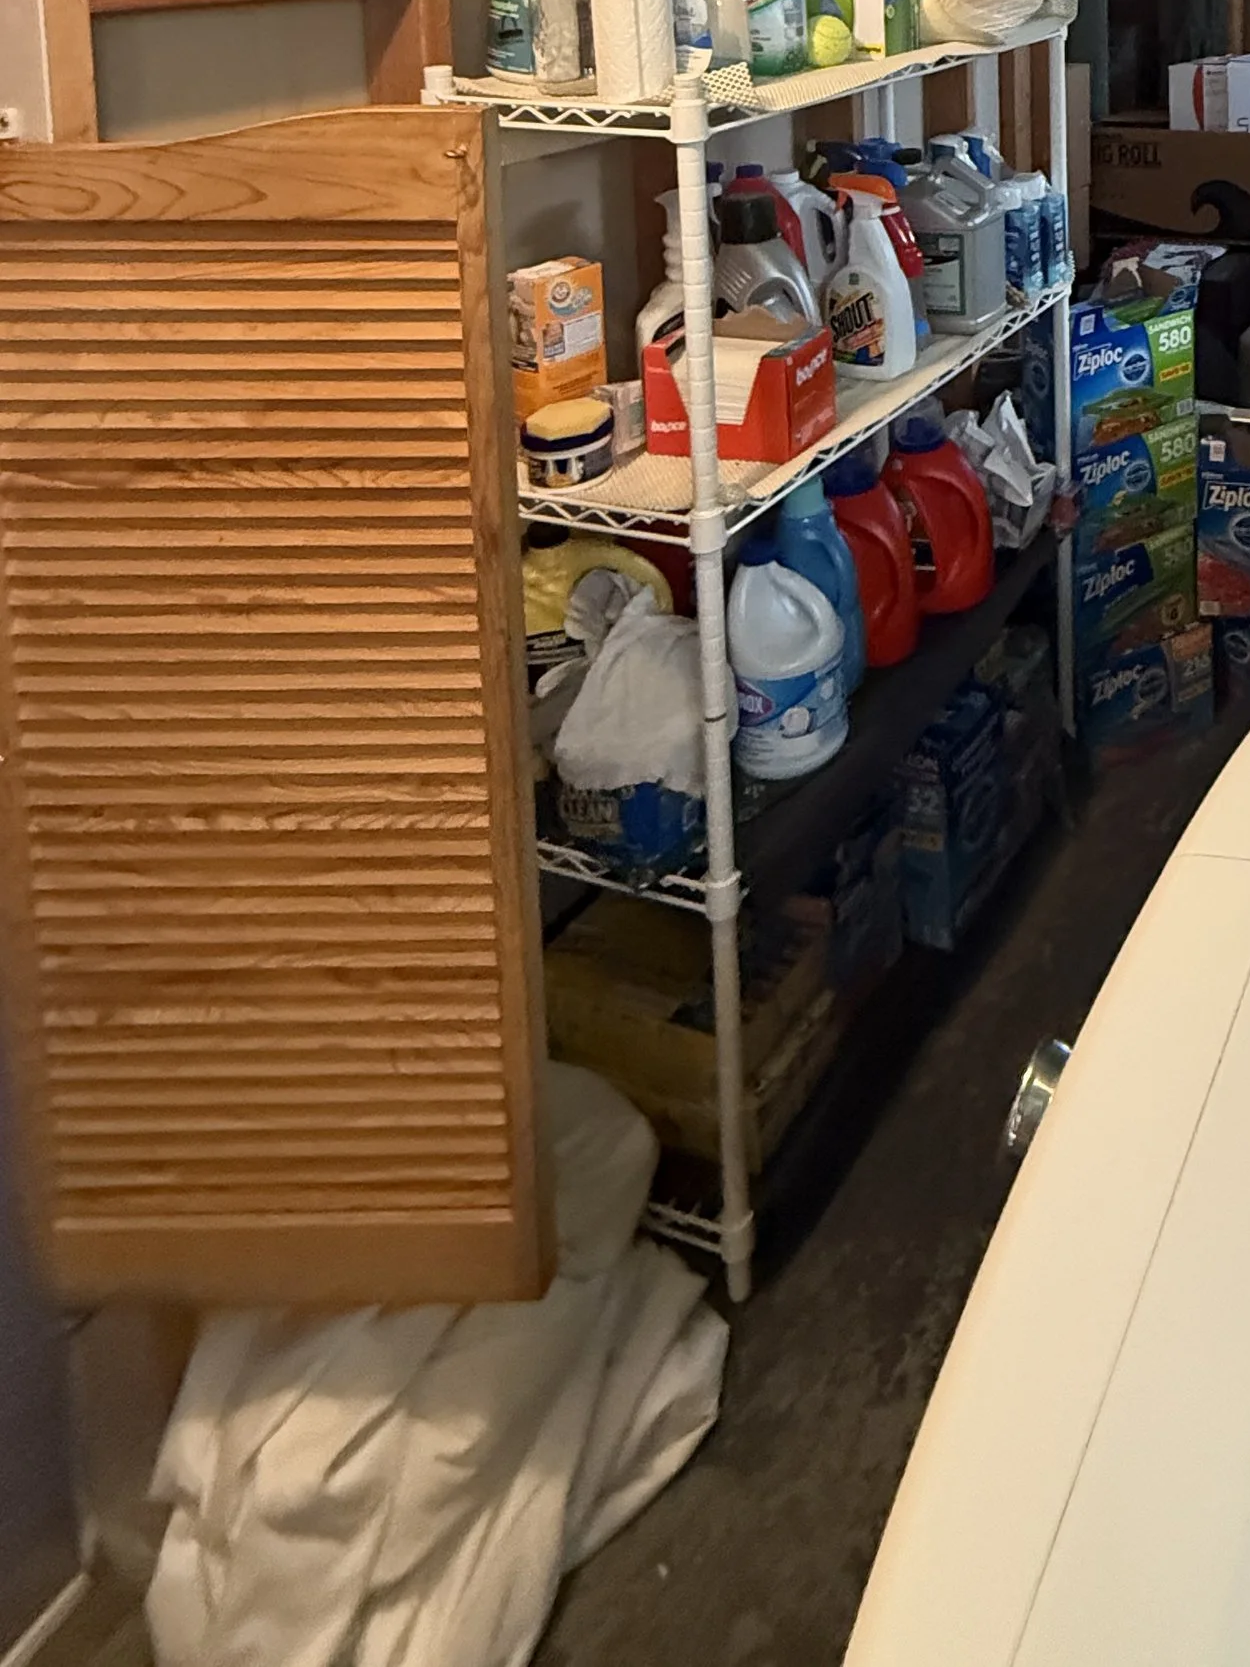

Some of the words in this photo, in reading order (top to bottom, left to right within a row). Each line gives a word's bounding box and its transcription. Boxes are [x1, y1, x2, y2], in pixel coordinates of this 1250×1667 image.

[831, 291, 874, 343] SHOUT
[1158, 326, 1192, 352] 580
[1077, 347, 1123, 376] Ziploc
[1080, 450, 1131, 485] Ziploc
[1083, 559, 1136, 602] Ziploc
[1091, 664, 1146, 707] Ziploc
